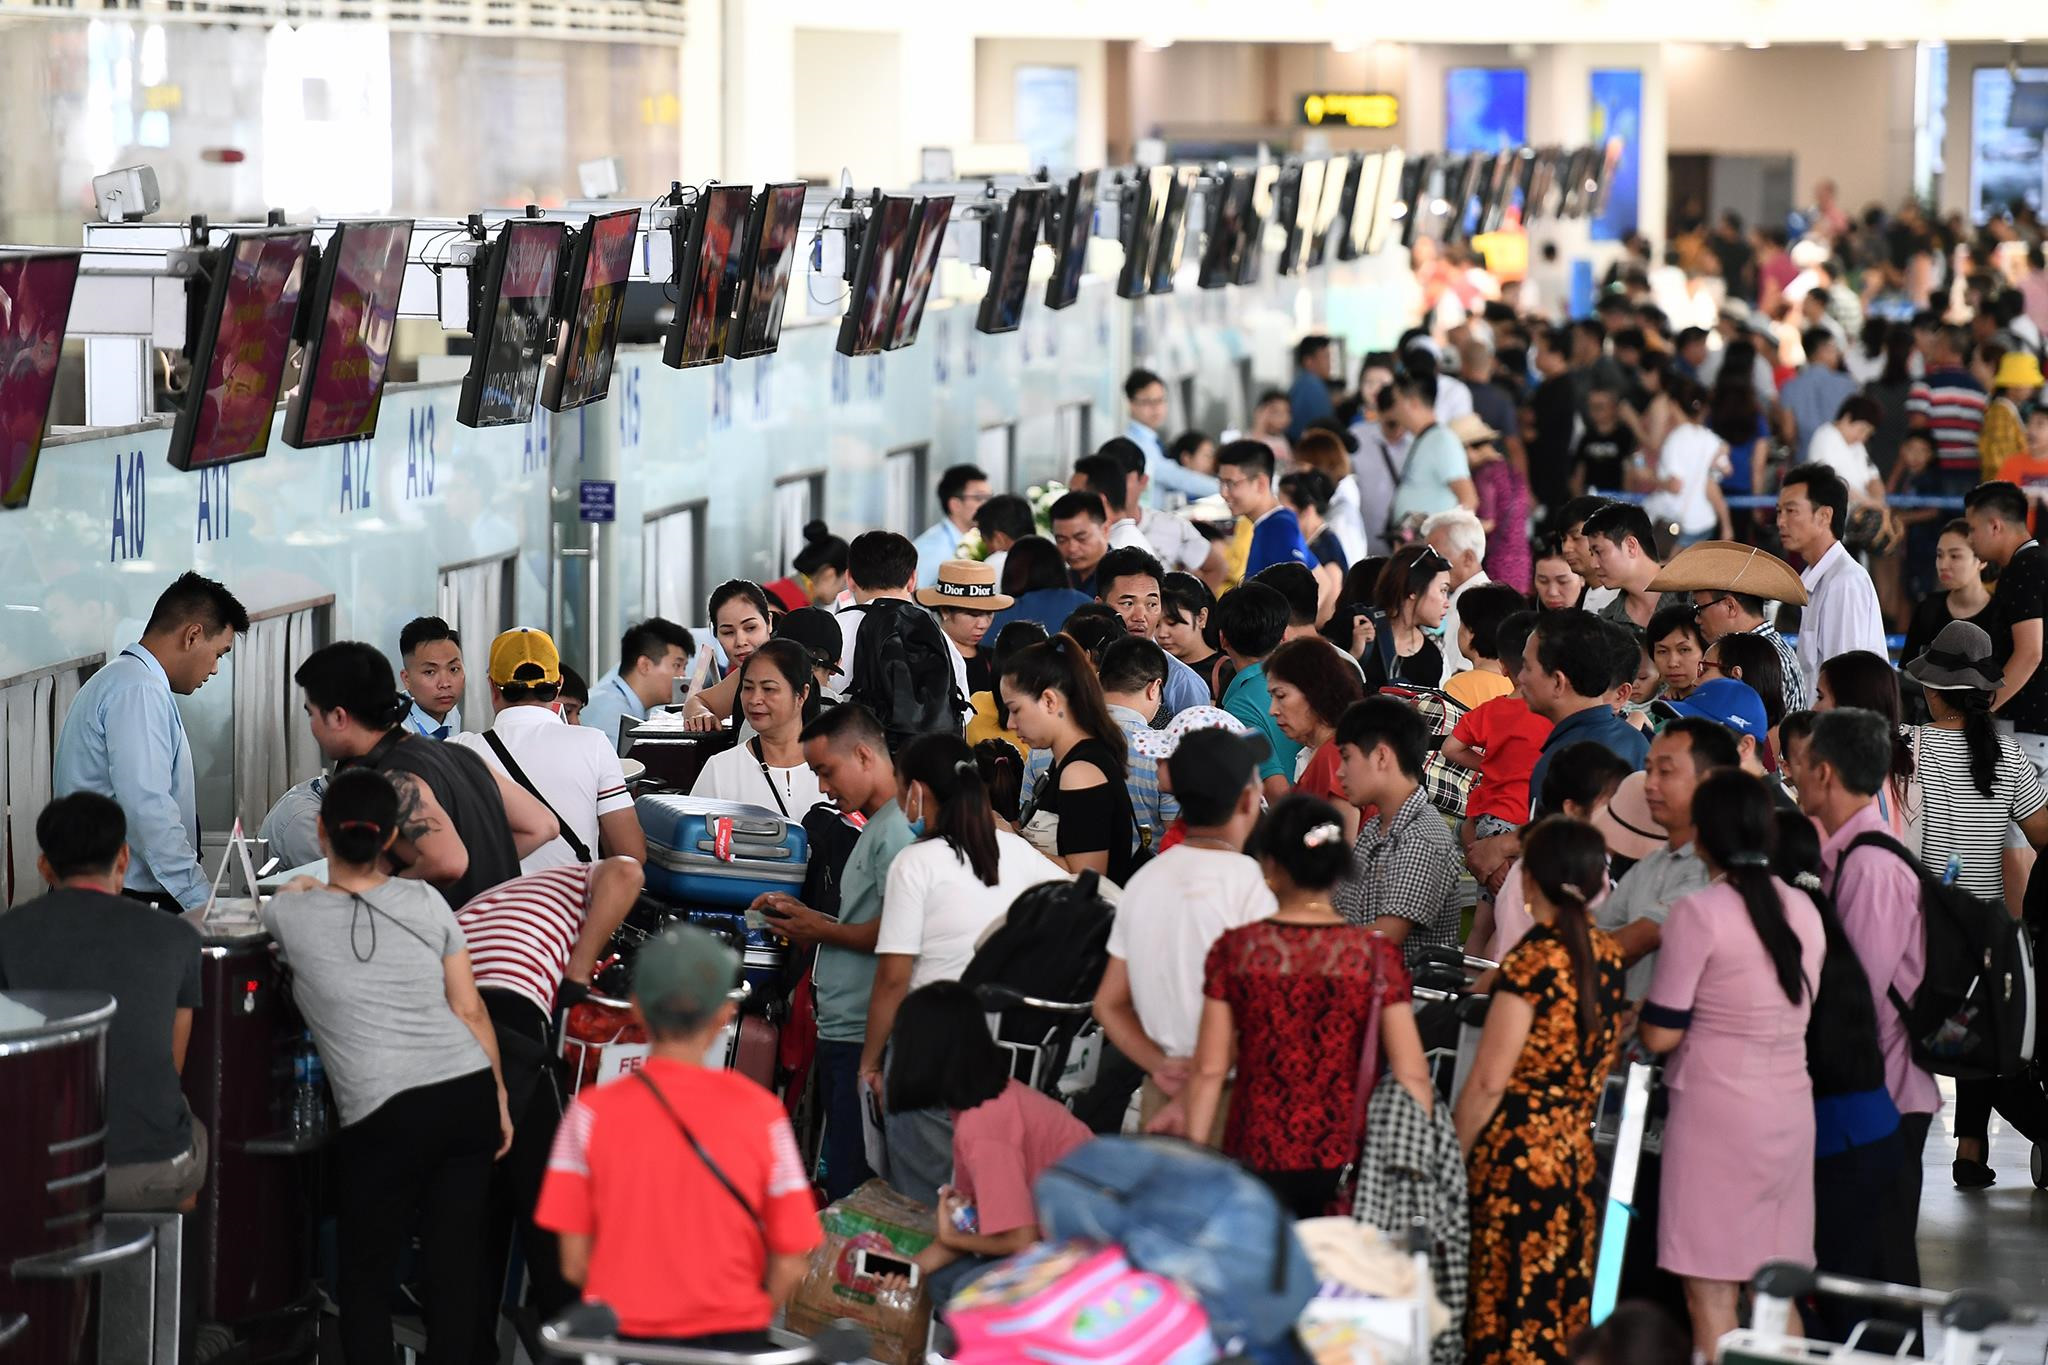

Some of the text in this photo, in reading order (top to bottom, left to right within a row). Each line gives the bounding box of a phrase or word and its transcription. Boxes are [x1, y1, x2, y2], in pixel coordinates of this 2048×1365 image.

[484, 372, 500, 406] HO
[340, 439, 370, 513] A12
[405, 405, 434, 499] A13
[111, 450, 145, 562] A10
[197, 463, 229, 543] A11
[944, 583, 964, 595] Dior
[969, 585, 991, 595] Dior
